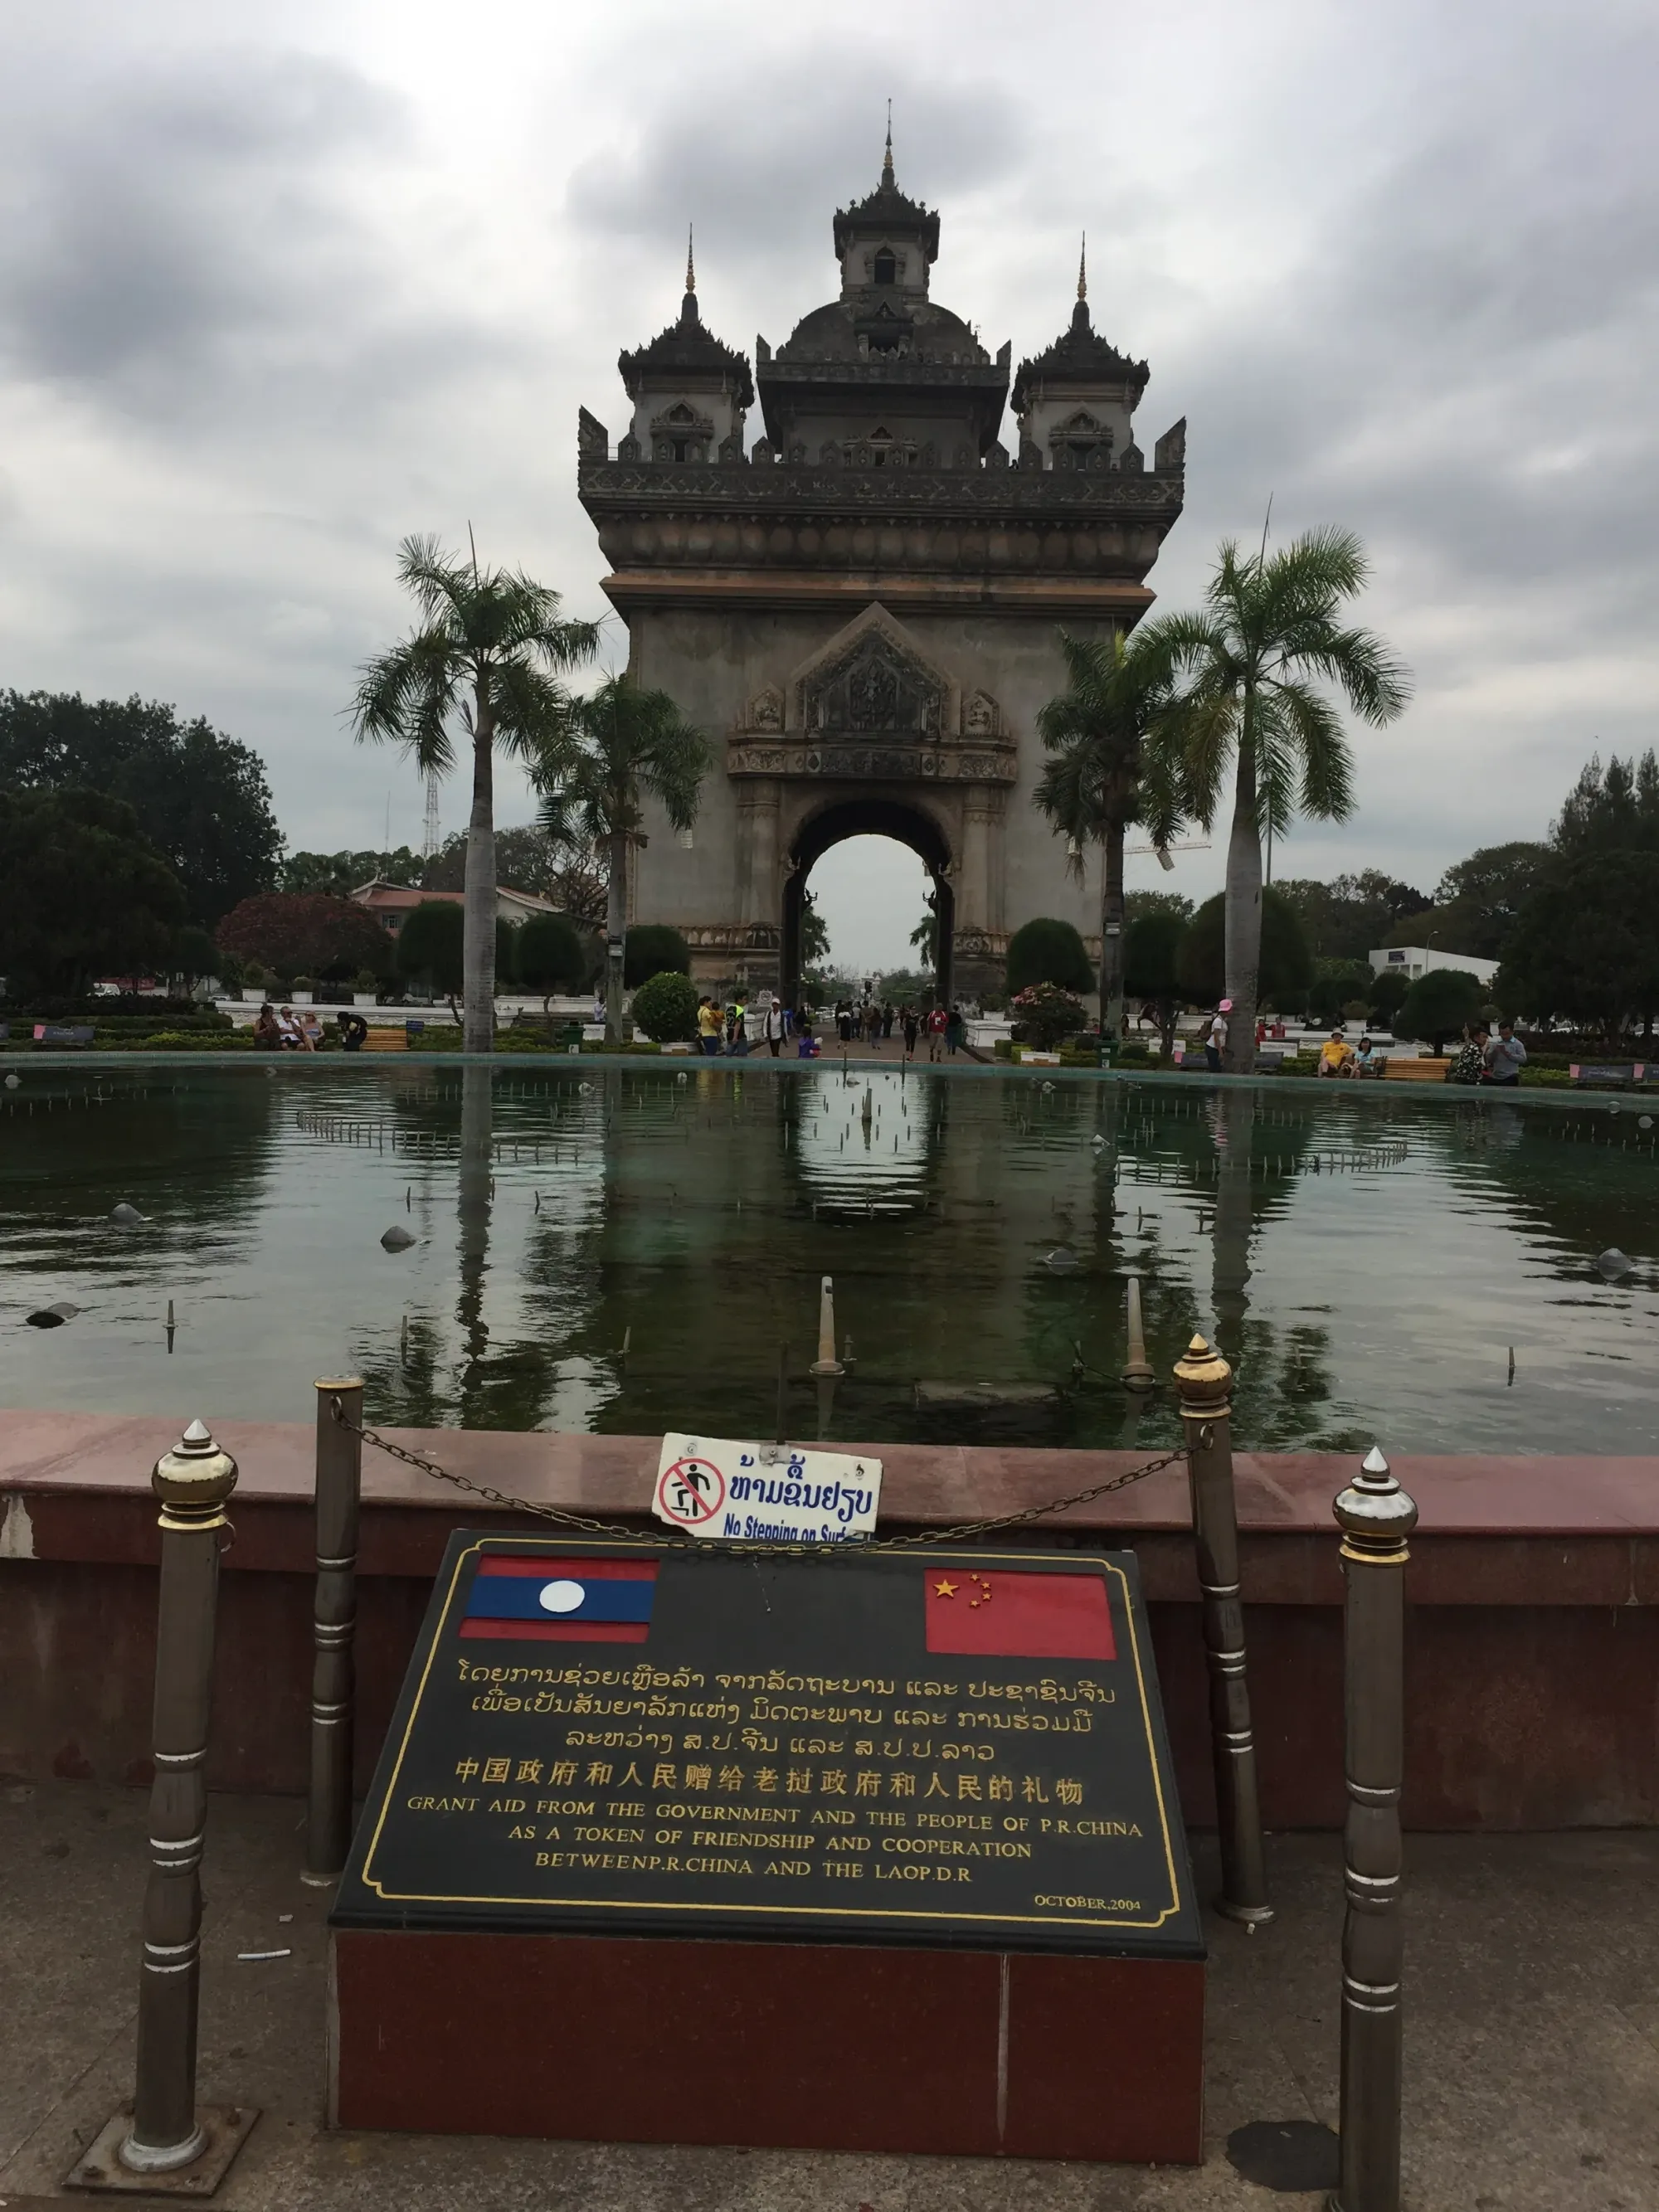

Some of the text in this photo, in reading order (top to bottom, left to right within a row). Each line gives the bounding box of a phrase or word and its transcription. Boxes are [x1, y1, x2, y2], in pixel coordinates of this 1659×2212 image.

[723, 1513, 741, 1536] No
[801, 1528, 816, 1541] on
[907, 1681, 957, 1695] ແລະ
[750, 1697, 882, 1723] ມິດຕະພາບ
[894, 1710, 946, 1725] ແລະ
[566, 1725, 673, 1754] ລະຫວ່າງ
[791, 1738, 844, 1753] ແລະ
[455, 1757, 1082, 1805] 中国政府和人民赠给老挝政府和人民的礼物
[408, 1796, 1143, 1837] GRANT AID FROM THE GOVERNMENT AND THE PEOPLE OF P.R.CHINA
[508, 1826, 1031, 1858] AS A TOKEN OF FRIENDSHIP AND COOPERATION
[764, 1861, 810, 1875] AND
[822, 1862, 864, 1878] THE
[1034, 1895, 1141, 1911] OCTOBER,2004
